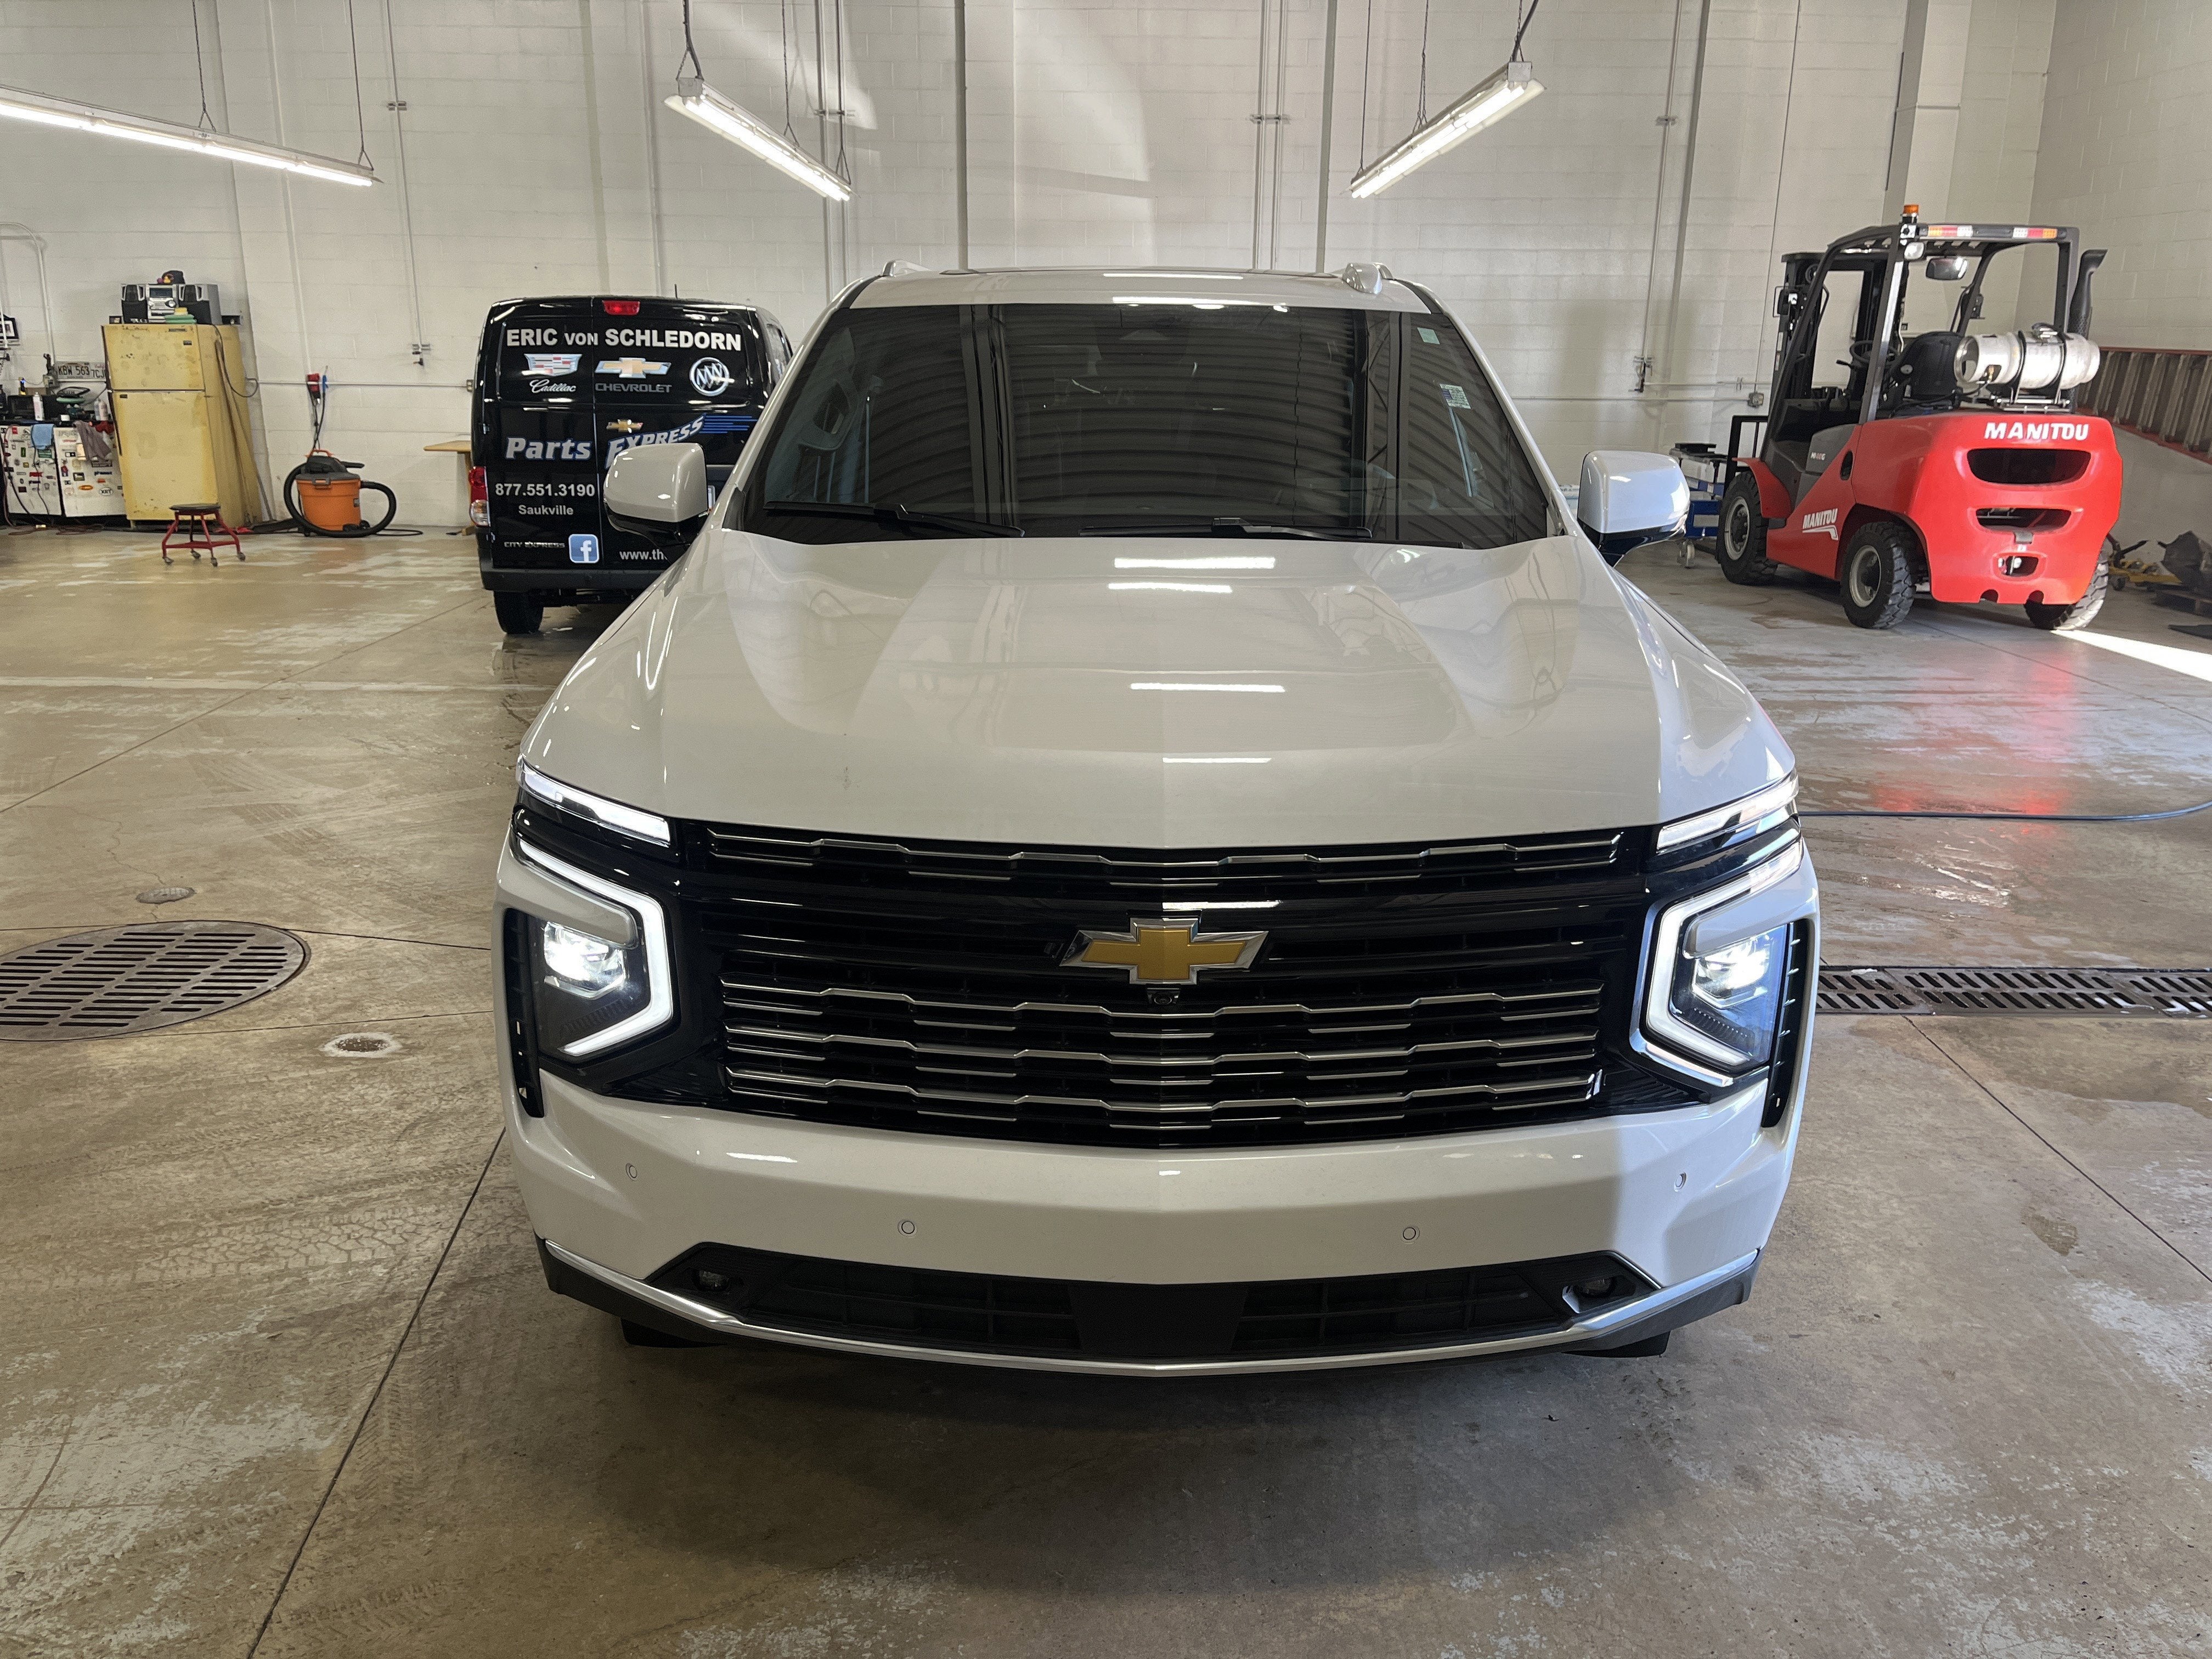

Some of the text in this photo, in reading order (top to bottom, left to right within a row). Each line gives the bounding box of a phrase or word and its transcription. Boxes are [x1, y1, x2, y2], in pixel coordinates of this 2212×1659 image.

[507, 328, 558, 346] ERIC
[605, 328, 741, 351] SCHLEDORN
[58, 365, 72, 375] KBW
[76, 366, 90, 375] 563
[529, 379, 576, 393] Cadillac
[595, 383, 672, 393] CHEVROLET
[1984, 422, 2089, 441] MANITOU
[505, 437, 592, 460] Parts
[495, 483, 595, 497] 877.551.3190
[518, 504, 574, 516] Saukville
[1803, 508, 1838, 529] MANITOU
[619, 549, 668, 560] www.th
